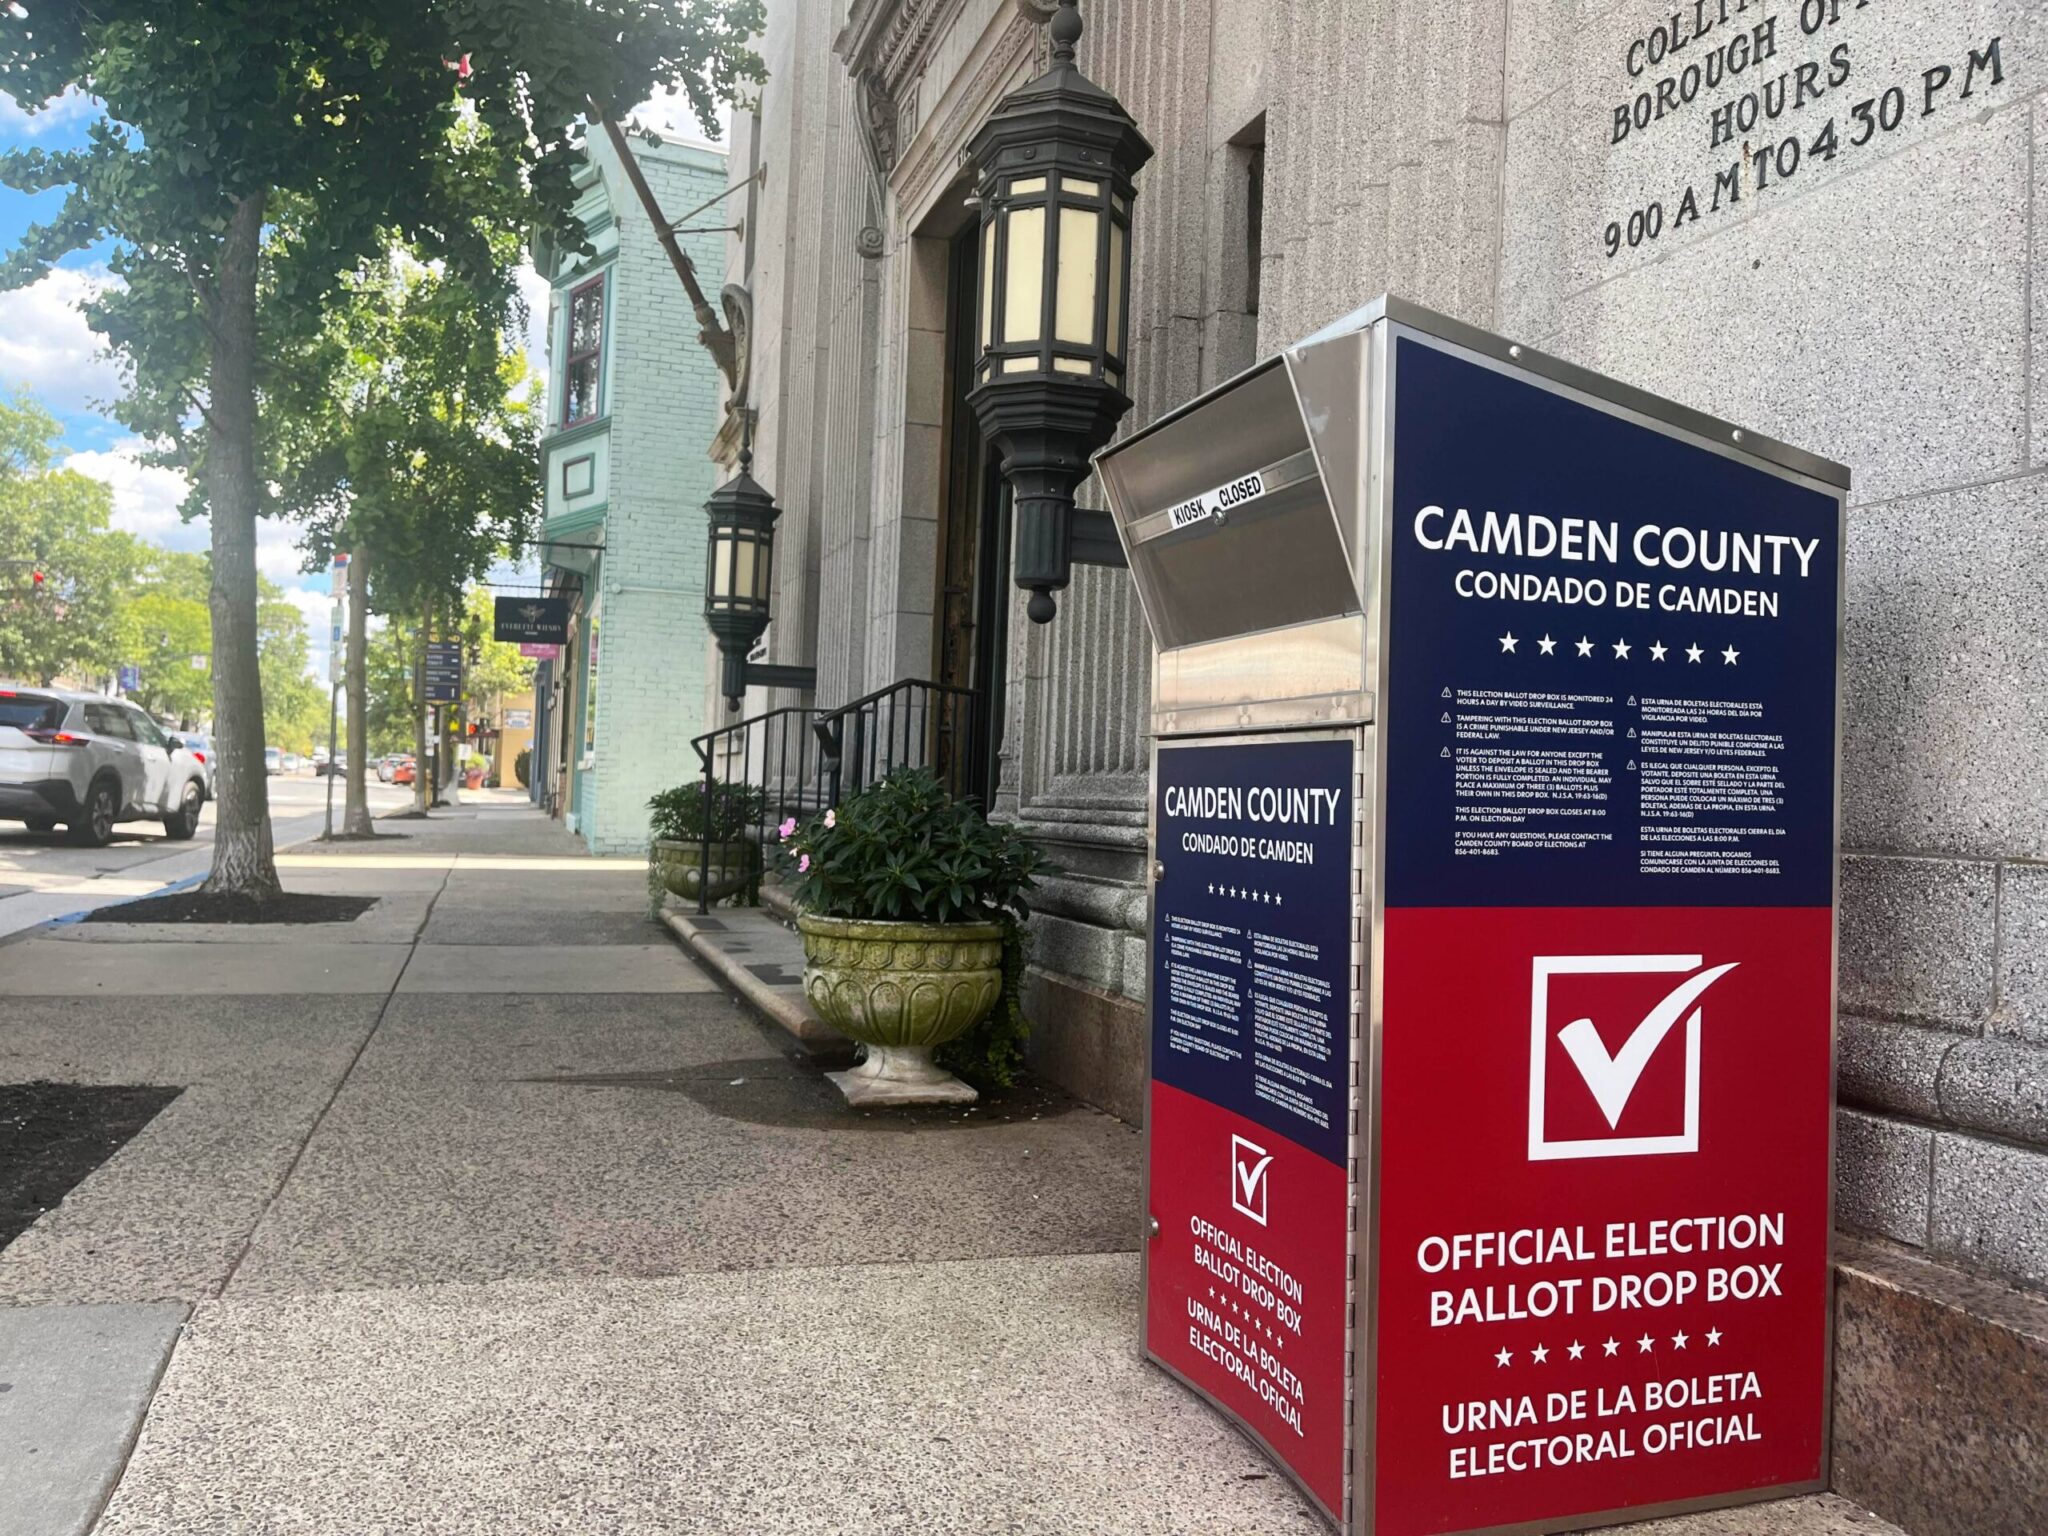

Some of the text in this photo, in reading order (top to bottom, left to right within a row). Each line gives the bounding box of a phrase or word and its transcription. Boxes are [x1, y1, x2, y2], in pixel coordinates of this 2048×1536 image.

[1611, 15, 1777, 144] BOROUGH
[1710, 43, 1850, 148] HOURS
[1752, 136, 1800, 190] TO
[1174, 476, 1261, 525] KIOSK CLOSED
[1414, 505, 1819, 577] CAMDEN COUNTY
[1455, 570, 1778, 617] CONDADO DE CAMDEN
[1457, 698, 1479, 706] HOURS
[1486, 699, 1498, 707] DAY
[1509, 700, 1528, 708] VIDEO
[1458, 690, 1471, 698] THIS
[1472, 690, 1503, 699] ELECTION
[1504, 692, 1527, 700] BALLOT
[1528, 693, 1545, 701] DROP
[1561, 694, 1566, 702] IS
[1568, 695, 1604, 703] MONITORED
[1457, 715, 1493, 723] TAMPERING
[1494, 716, 1511, 724] WITH
[1512, 717, 1526, 725] THIS
[1527, 718, 1557, 726] ELECTION
[1582, 719, 1599, 727] DROP
[1600, 720, 1613, 728] BOX
[1457, 731, 1483, 739] FEDERAL
[1469, 724, 1488, 732] CRIME
[1490, 725, 1528, 733] PUNISHABLE
[1529, 726, 1551, 734] UNDER
[1568, 727, 1588, 735] JERSEY
[1590, 728, 1614, 736] AND/OR
[1456, 765, 1480, 773] UNLESS
[1494, 766, 1526, 774] ENVELOPE
[1534, 767, 1557, 775] SEALED
[1586, 768, 1608, 776] BEARER
[1463, 748, 1469, 756] IS
[1527, 750, 1539, 758] FOR
[1541, 751, 1566, 759] ANYONE
[1591, 752, 1603, 760] THE
[1478, 757, 1487, 765] TO
[1521, 758, 1544, 766] BALLOT
[1554, 759, 1567, 767] THIS
[1586, 760, 1599, 768] BOX
[1165, 786, 1341, 825] CAMDEN COUNTY
[1182, 833, 1313, 864] CONDADO DE CAMDEN
[1484, 840, 1510, 848] COUNTY
[1511, 840, 1533, 848] BOARD
[1191, 1216, 1302, 1305] OFFICIAL ELECTION
[1417, 1213, 1784, 1273] OFFICIAL ELECTION
[1195, 1244, 1301, 1336] BALLOT DROP BOX
[1430, 1264, 1782, 1327] BALLOT DROP BOX
[1188, 1297, 1303, 1405] URNA DE LA BOLETA
[1190, 1326, 1303, 1437] ELECTORAL OFICIAL
[1443, 1372, 1762, 1434] URNA DE LA BOLETA
[1450, 1413, 1761, 1478] ELECTORAL OFICIAL
